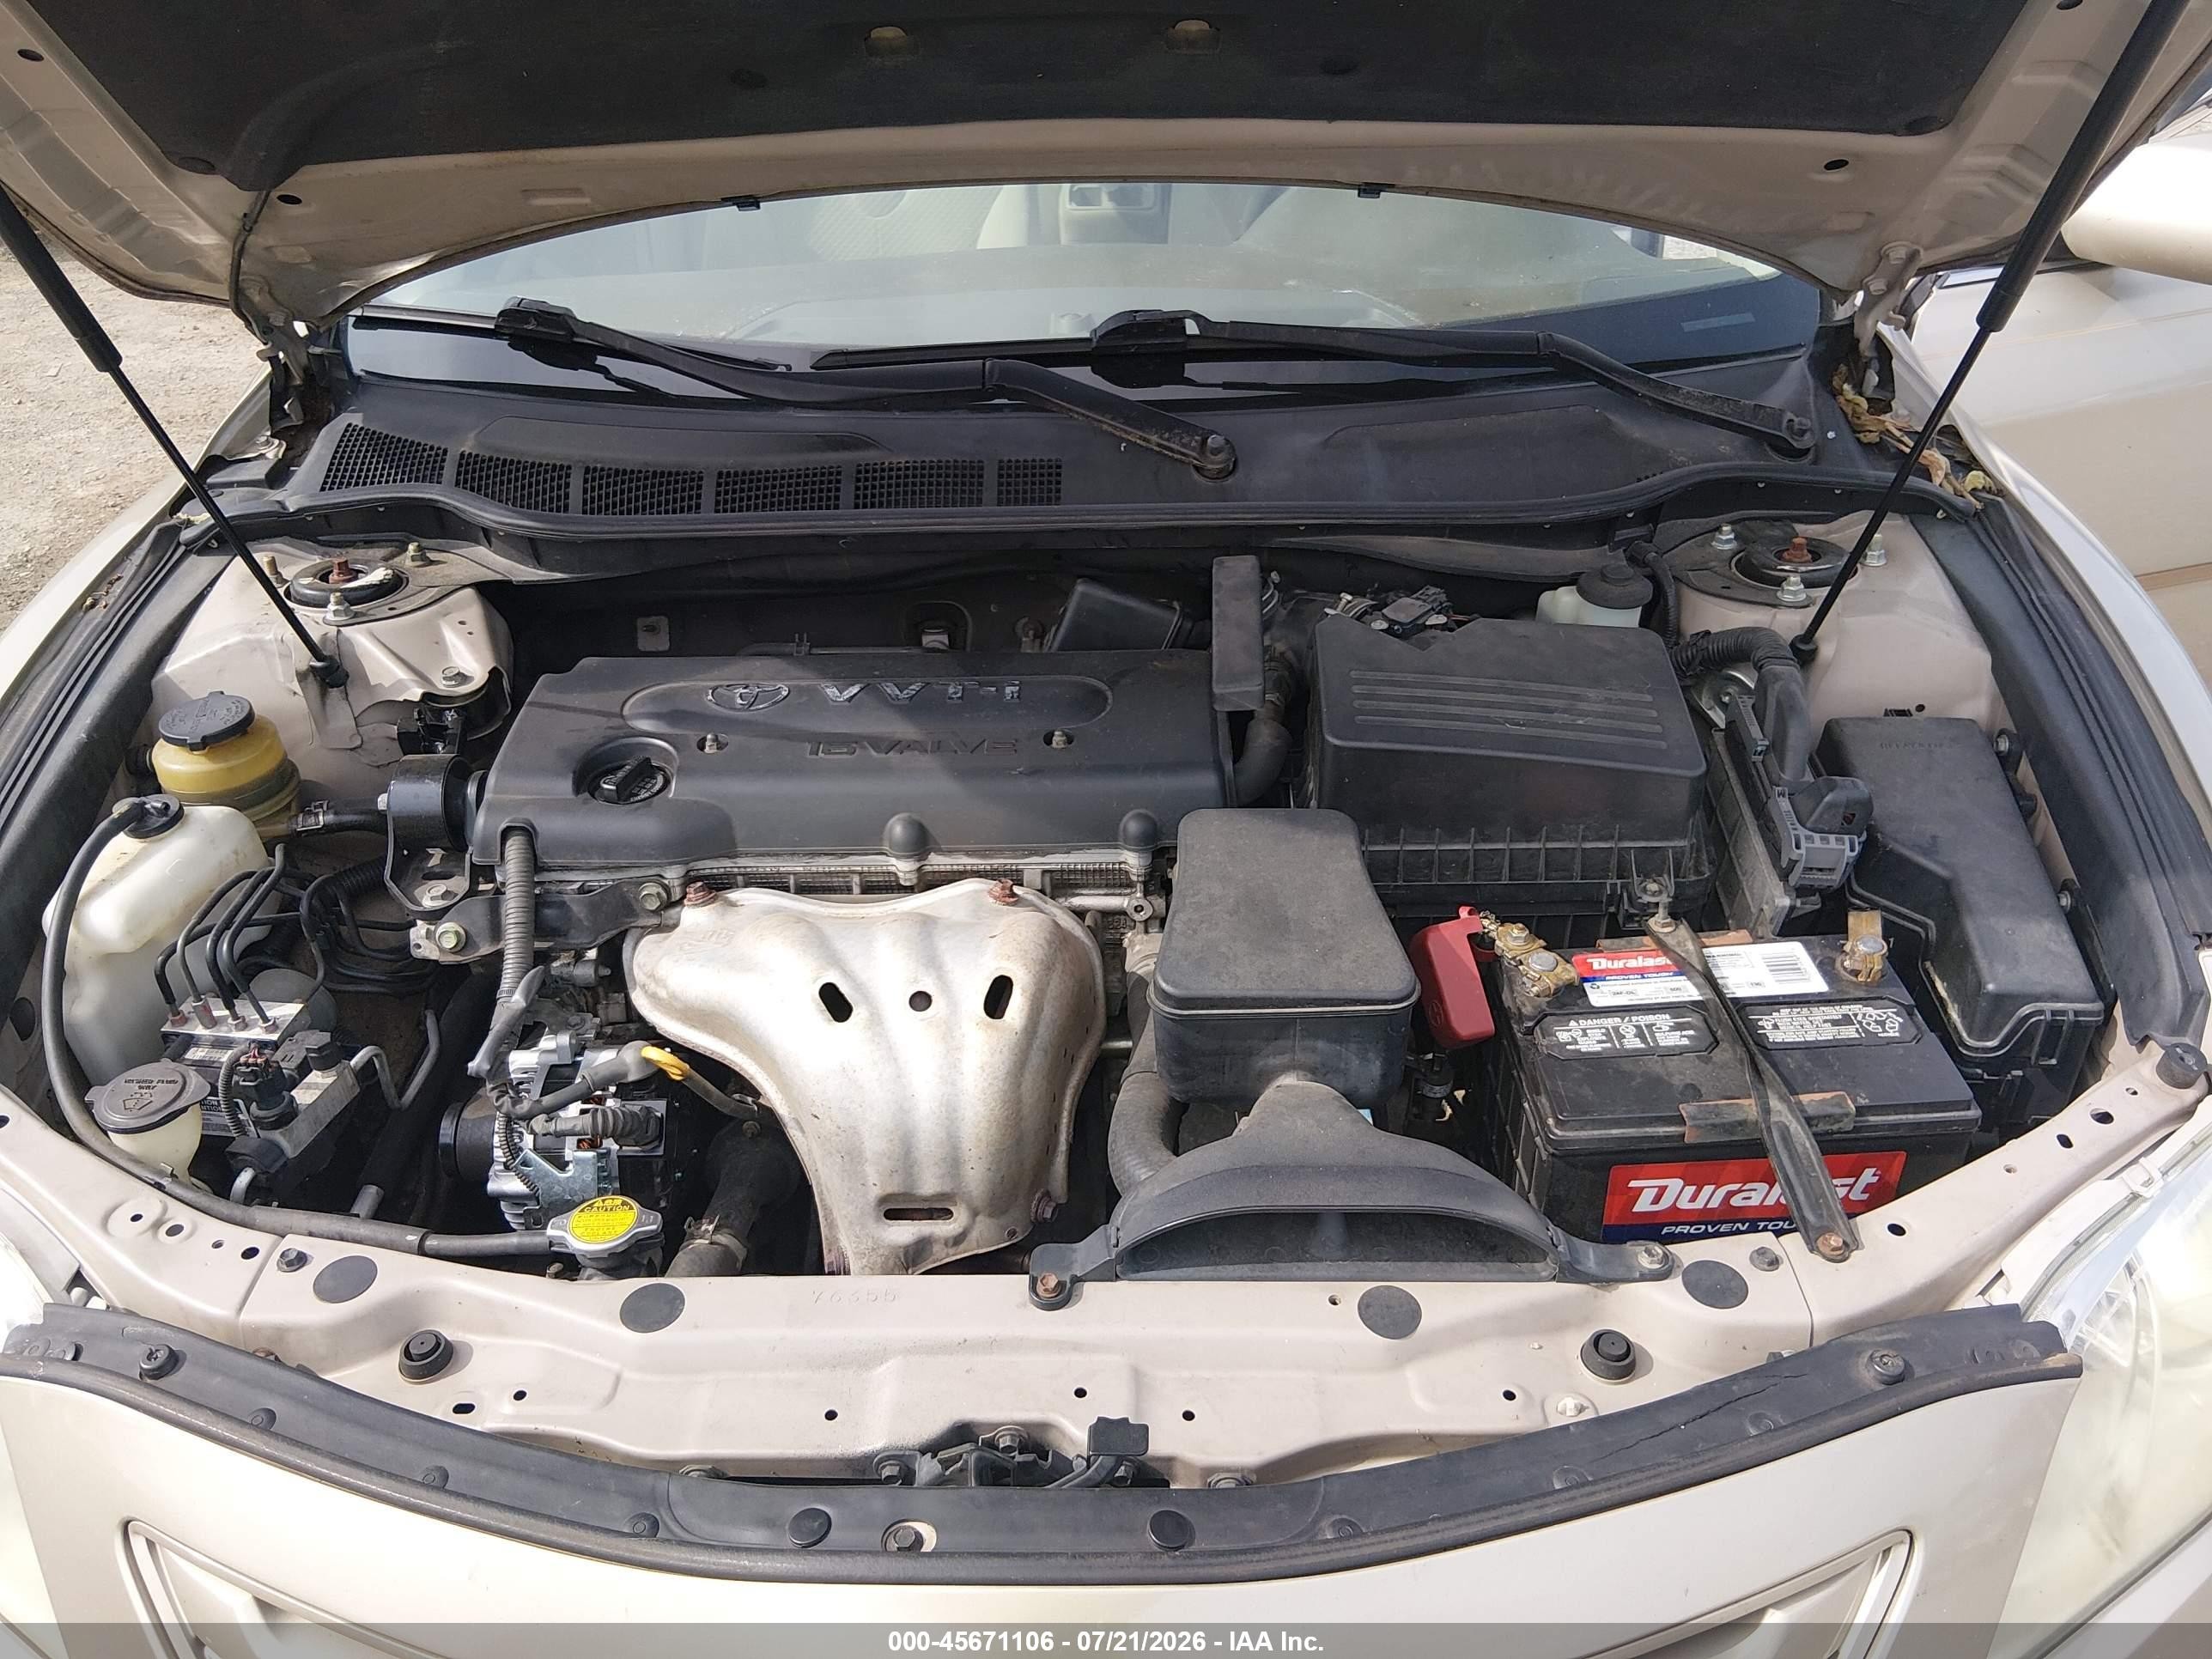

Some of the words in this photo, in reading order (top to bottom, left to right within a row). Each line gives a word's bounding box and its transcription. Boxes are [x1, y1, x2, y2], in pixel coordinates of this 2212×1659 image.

[1579, 1017, 1621, 1026] DANGER
[1632, 1014, 1670, 1023] POISON
[1627, 1167, 1881, 1212] Duralst
[1661, 1223, 1750, 1235] PROVEN
[1757, 1221, 1796, 1231] TOU
